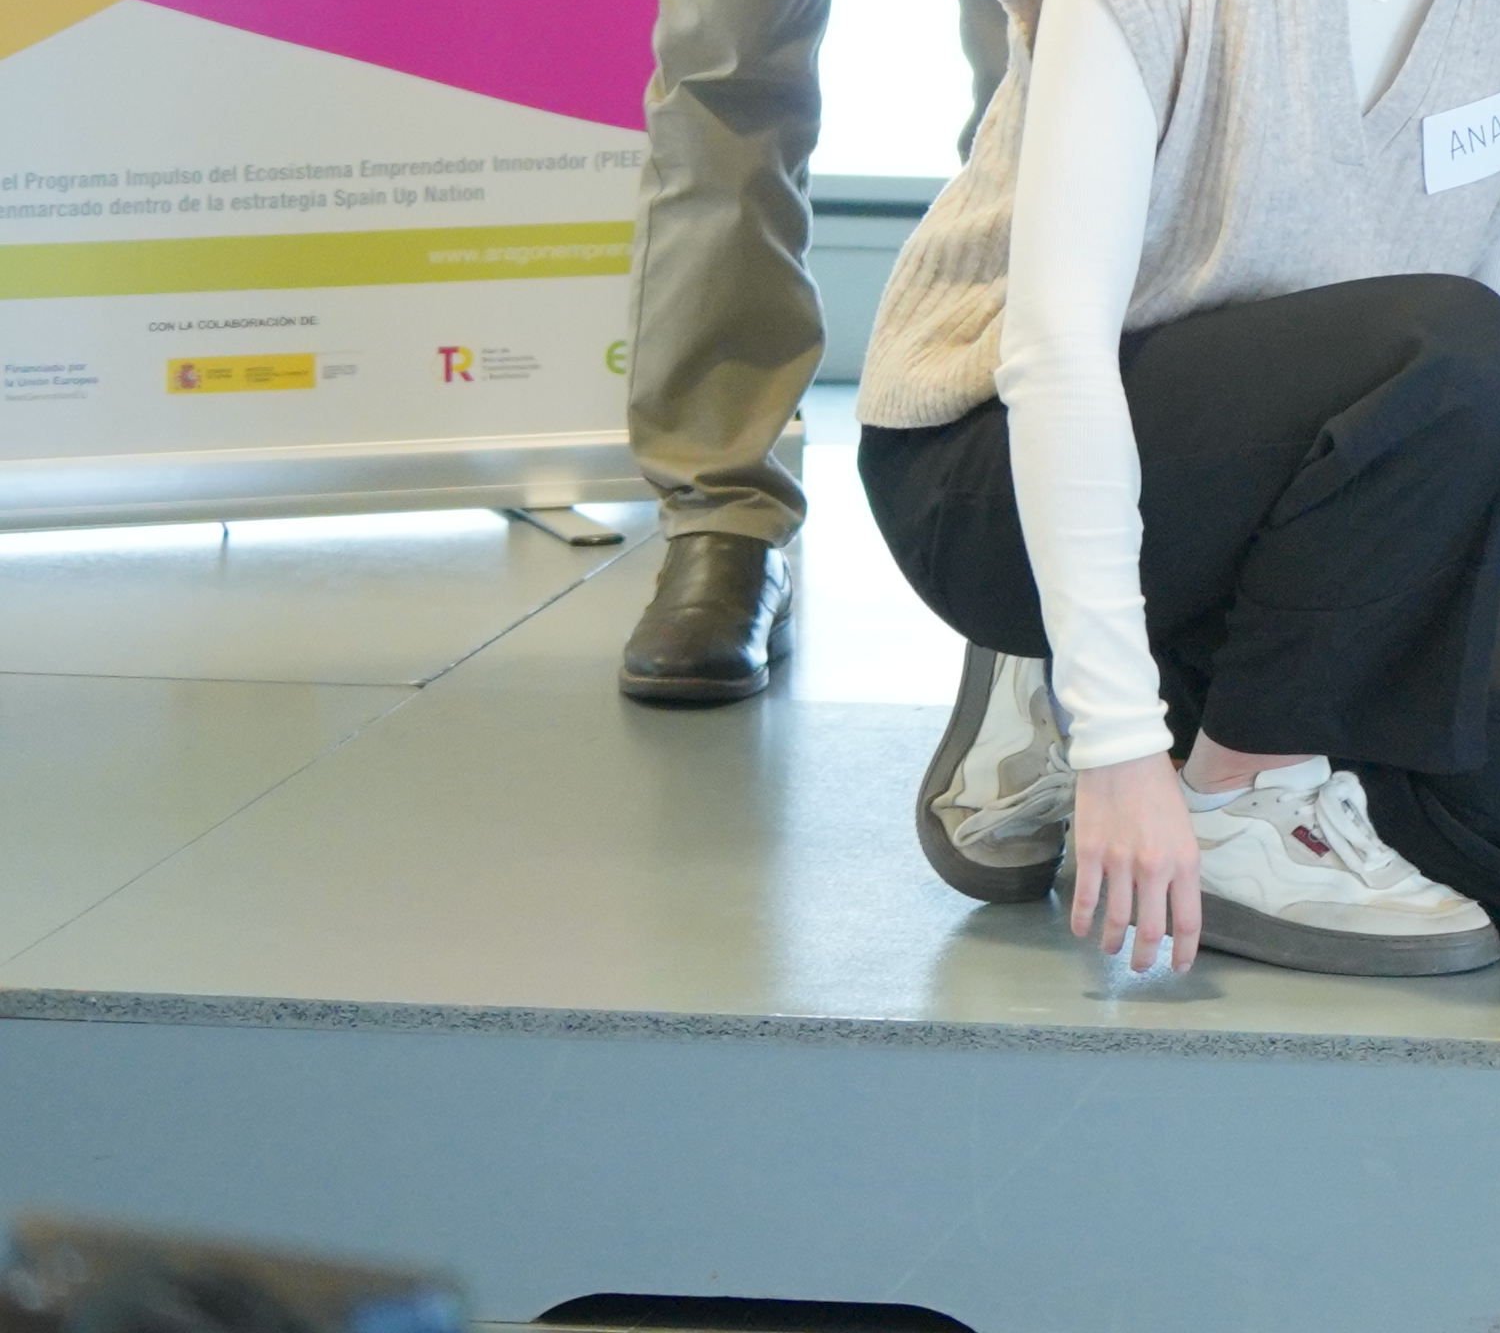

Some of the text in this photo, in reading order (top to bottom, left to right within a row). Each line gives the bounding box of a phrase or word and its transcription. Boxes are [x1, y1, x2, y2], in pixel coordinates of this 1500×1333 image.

[24, 171, 119, 193] Programa
[125, 167, 202, 190] Impulso
[208, 165, 238, 184] del
[244, 162, 353, 182] Ecosistema
[359, 155, 487, 182] Emprendedor
[492, 152, 588, 173] Innovador
[109, 195, 172, 216] dentro
[178, 194, 201, 214] de
[207, 193, 224, 213] la
[230, 190, 329, 214] estrategia
[333, 187, 387, 210] Spain
[392, 186, 418, 208] Up
[423, 184, 486, 203] Nation
[149, 321, 175, 332] CON
